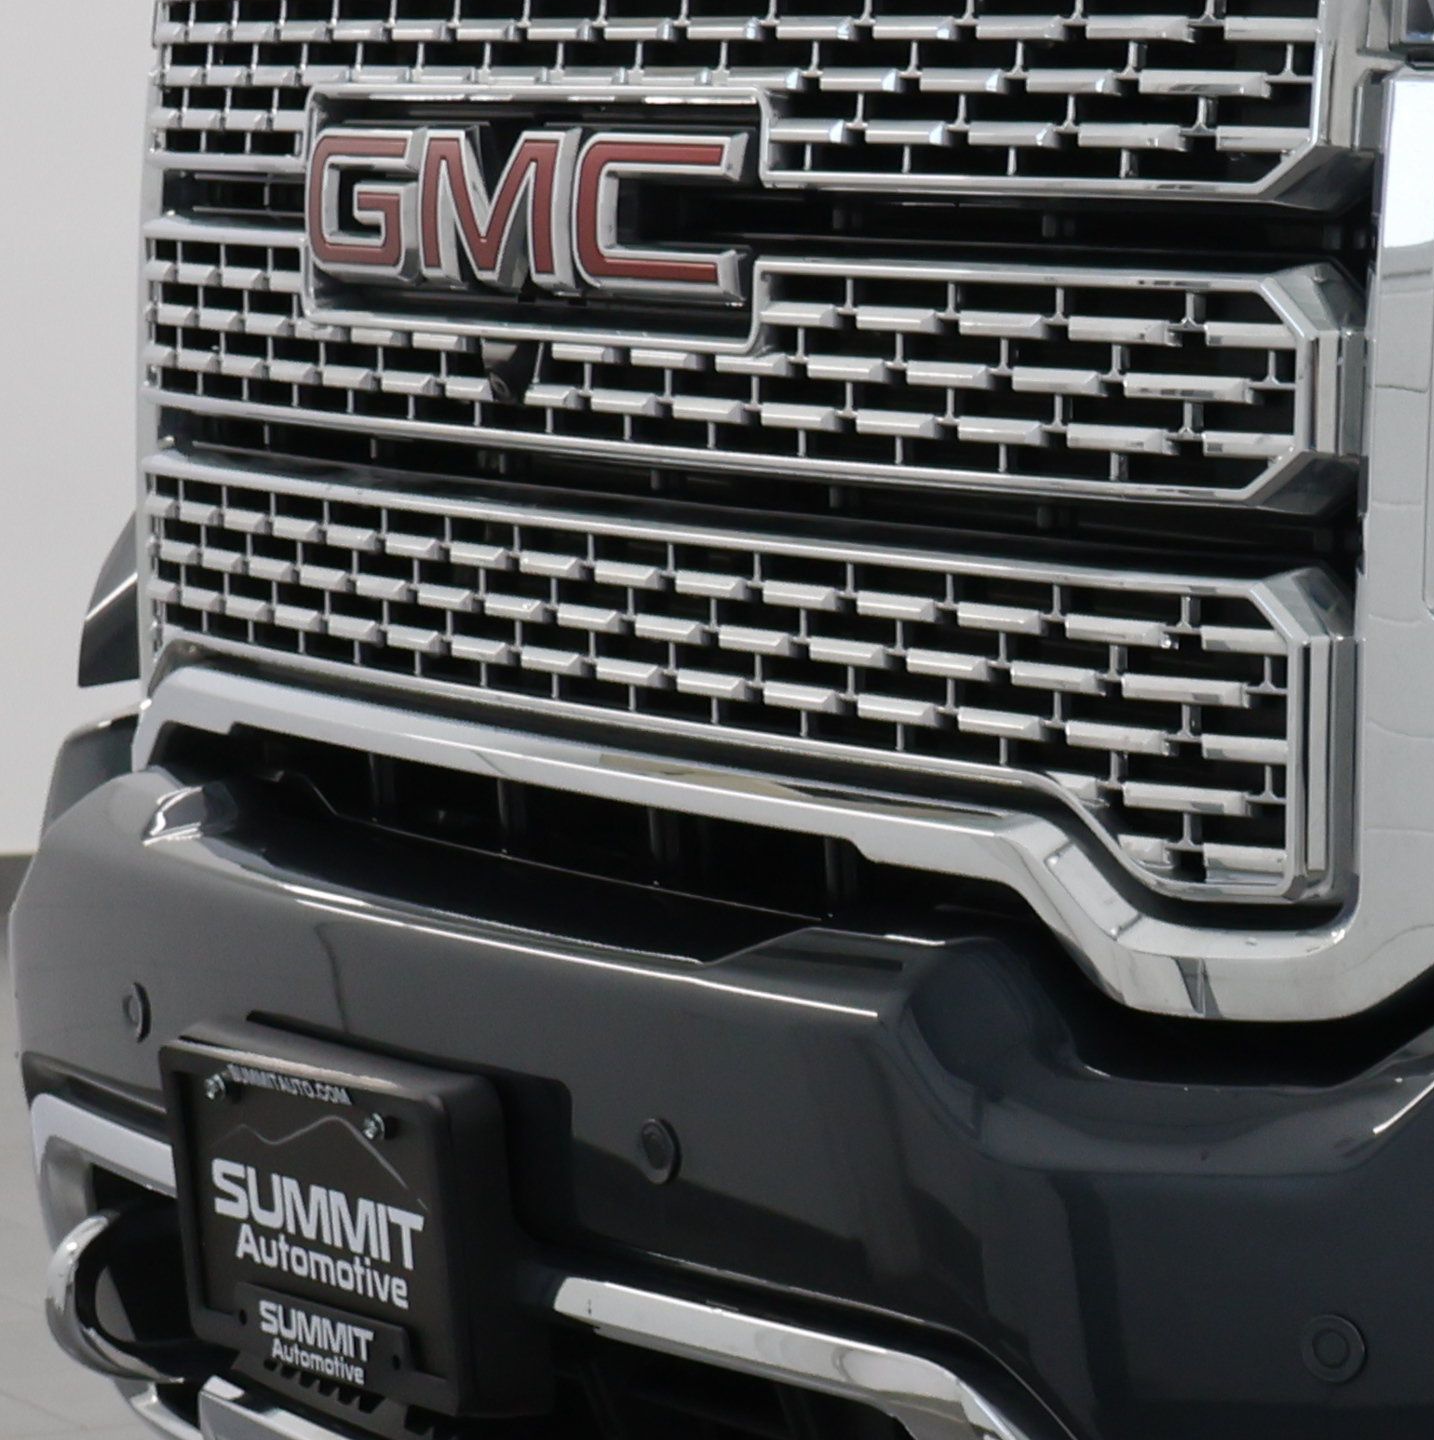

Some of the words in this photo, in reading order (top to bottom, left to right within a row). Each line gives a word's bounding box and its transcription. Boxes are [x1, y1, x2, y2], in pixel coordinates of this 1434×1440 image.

[305, 125, 748, 306] GMC
[211, 1157, 425, 1270] SUMMIT
[235, 1223, 410, 1310] Automotive
[258, 1299, 374, 1362] SUMMIT
[271, 1340, 366, 1386] Automotive
